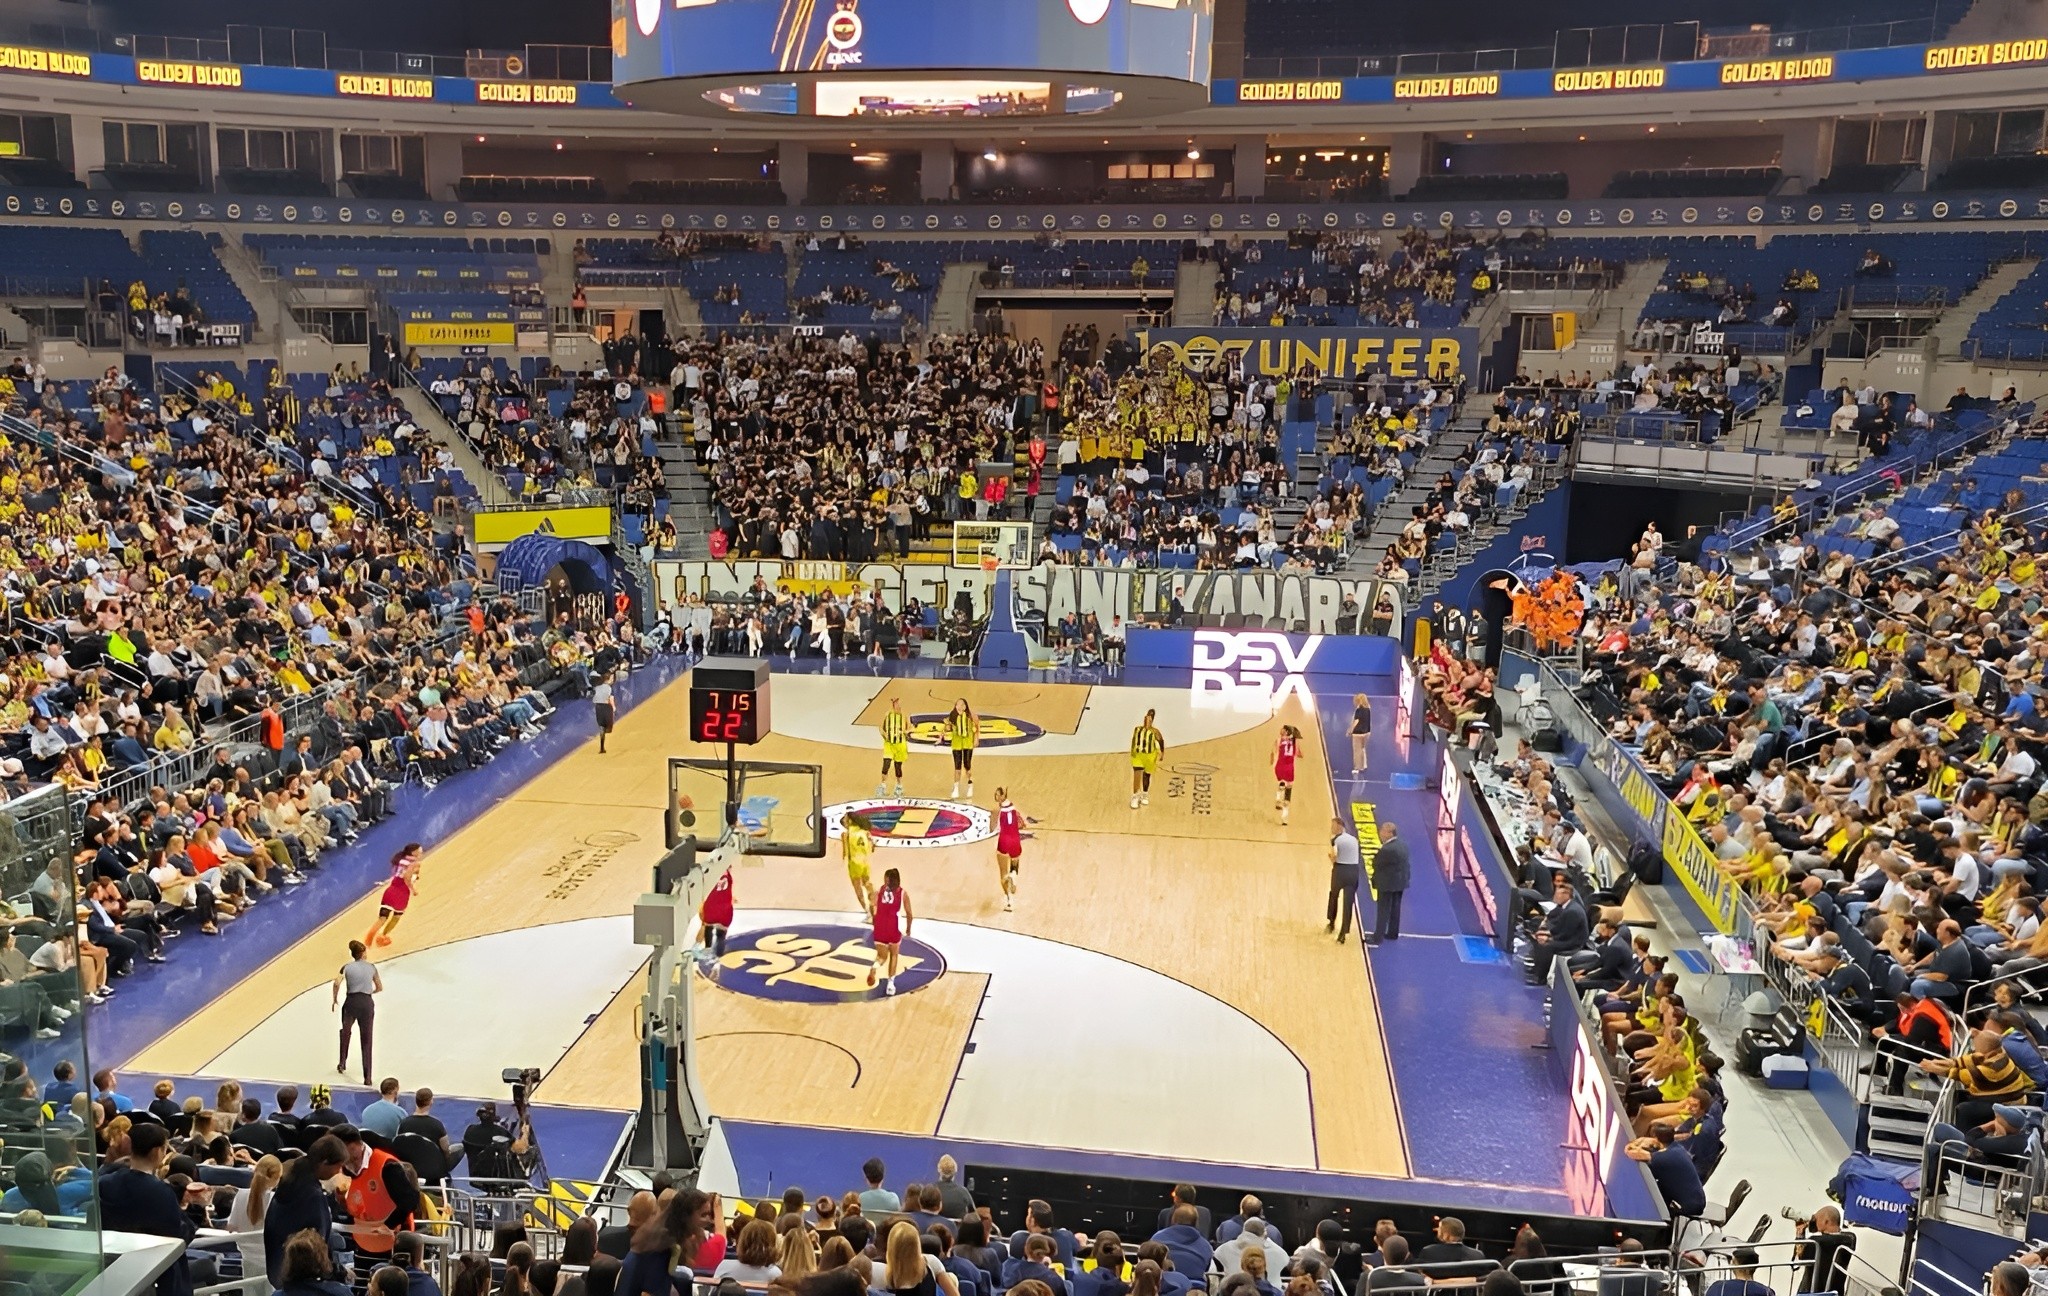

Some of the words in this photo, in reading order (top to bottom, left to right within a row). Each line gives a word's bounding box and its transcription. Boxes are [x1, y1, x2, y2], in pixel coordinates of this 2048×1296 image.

[49, 52, 91, 76] BLOOD
[1926, 44, 1990, 70] GOLDEN
[1991, 39, 2047, 64] BLOOD
[139, 61, 193, 84] GOLDEN
[196, 65, 242, 87] BLOOD
[1554, 71, 1612, 91] GOLDEN
[1614, 69, 1664, 89] BLOOD
[1721, 61, 1783, 84] GOLDEN
[1784, 58, 1832, 79] BLOOD
[339, 75, 388, 95] GOLDEN
[391, 79, 433, 98] BLOOD
[479, 83, 530, 102] GOLDEN
[533, 86, 577, 104] BLOOD
[1240, 83, 1293, 100] GOLDEN
[1296, 82, 1342, 100] BLOOD
[1395, 78, 1449, 98] GOLDEN
[1452, 76, 1498, 95] BLOOD
[1192, 630, 1325, 673] DSV
[709, 692, 719, 709] 7
[732, 693, 750, 711] 15
[703, 712, 742, 739] 22
[1571, 1022, 1621, 1186] DSV
